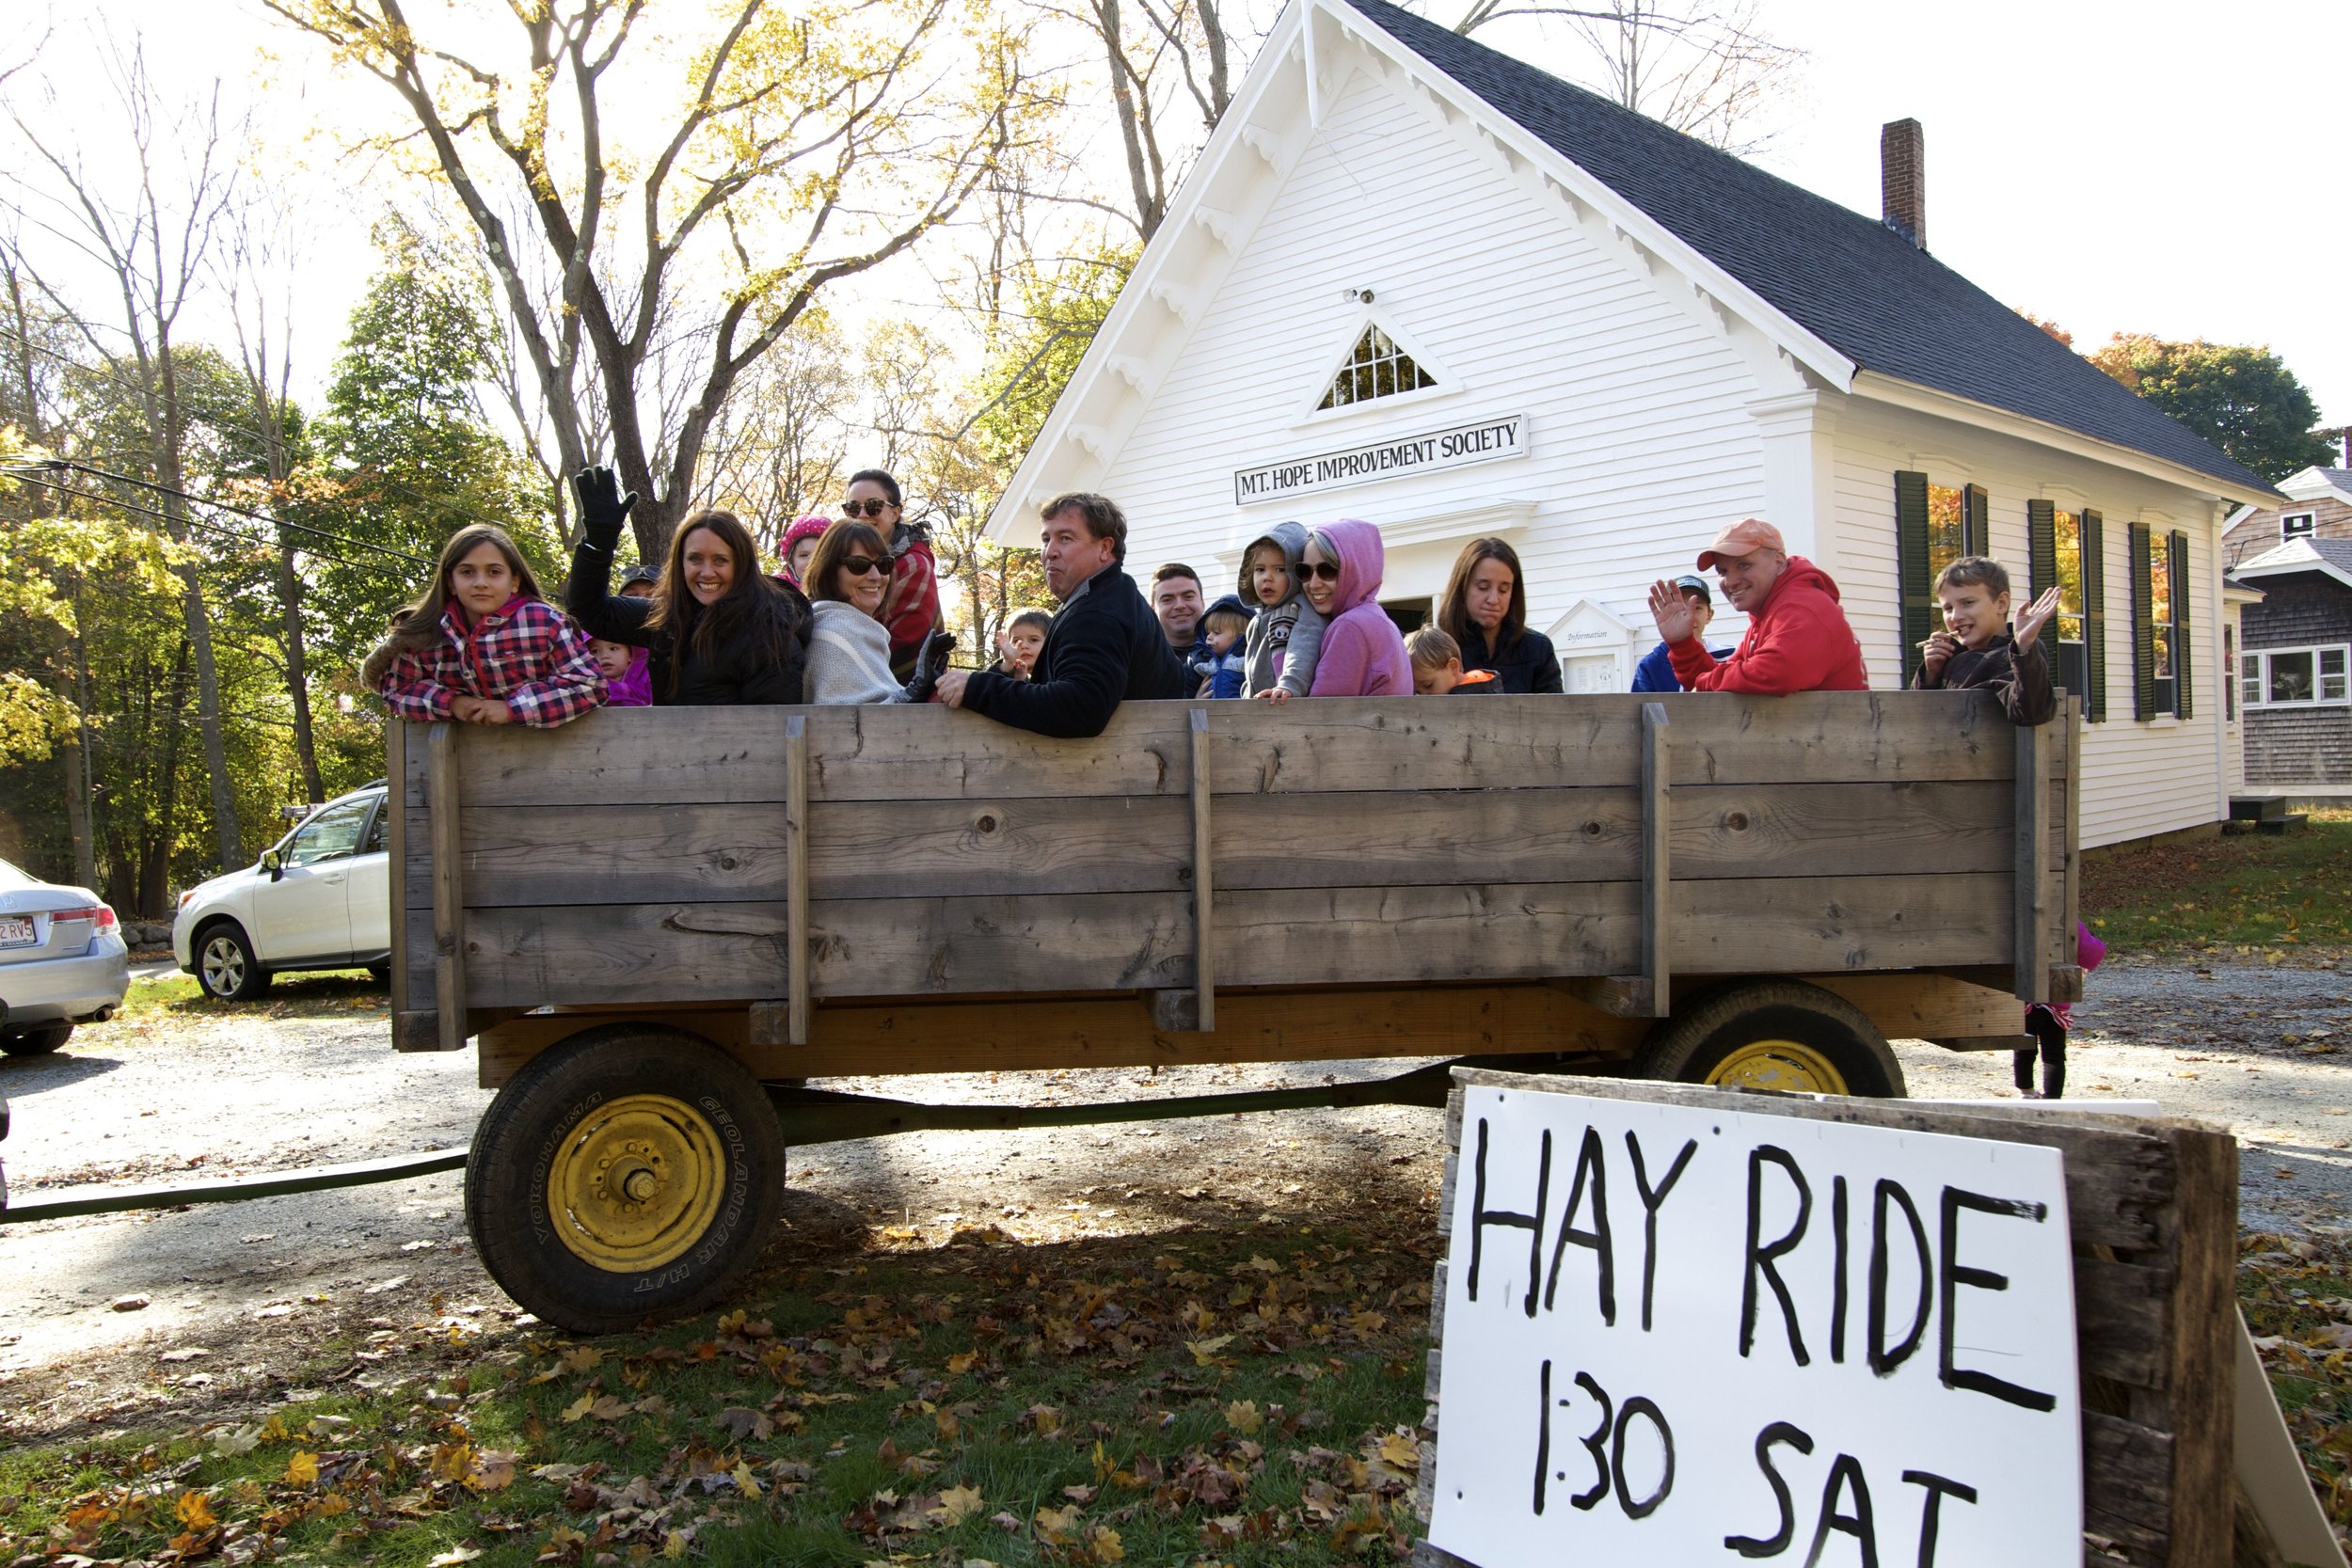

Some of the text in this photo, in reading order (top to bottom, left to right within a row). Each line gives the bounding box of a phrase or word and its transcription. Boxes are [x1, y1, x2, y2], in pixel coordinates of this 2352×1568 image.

[1241, 422, 1518, 496] MT. HOPE IMPROVEMENT SOCIETY
[1567, 631, 1607, 643] Information
[531, 1091, 602, 1244] YOKOHAMA
[633, 1096, 748, 1292] GEOLANDAR H/T
[1469, 1117, 2057, 1413] HAY RIDE
[1533, 1359, 1979, 1568] 1:30 SAT
